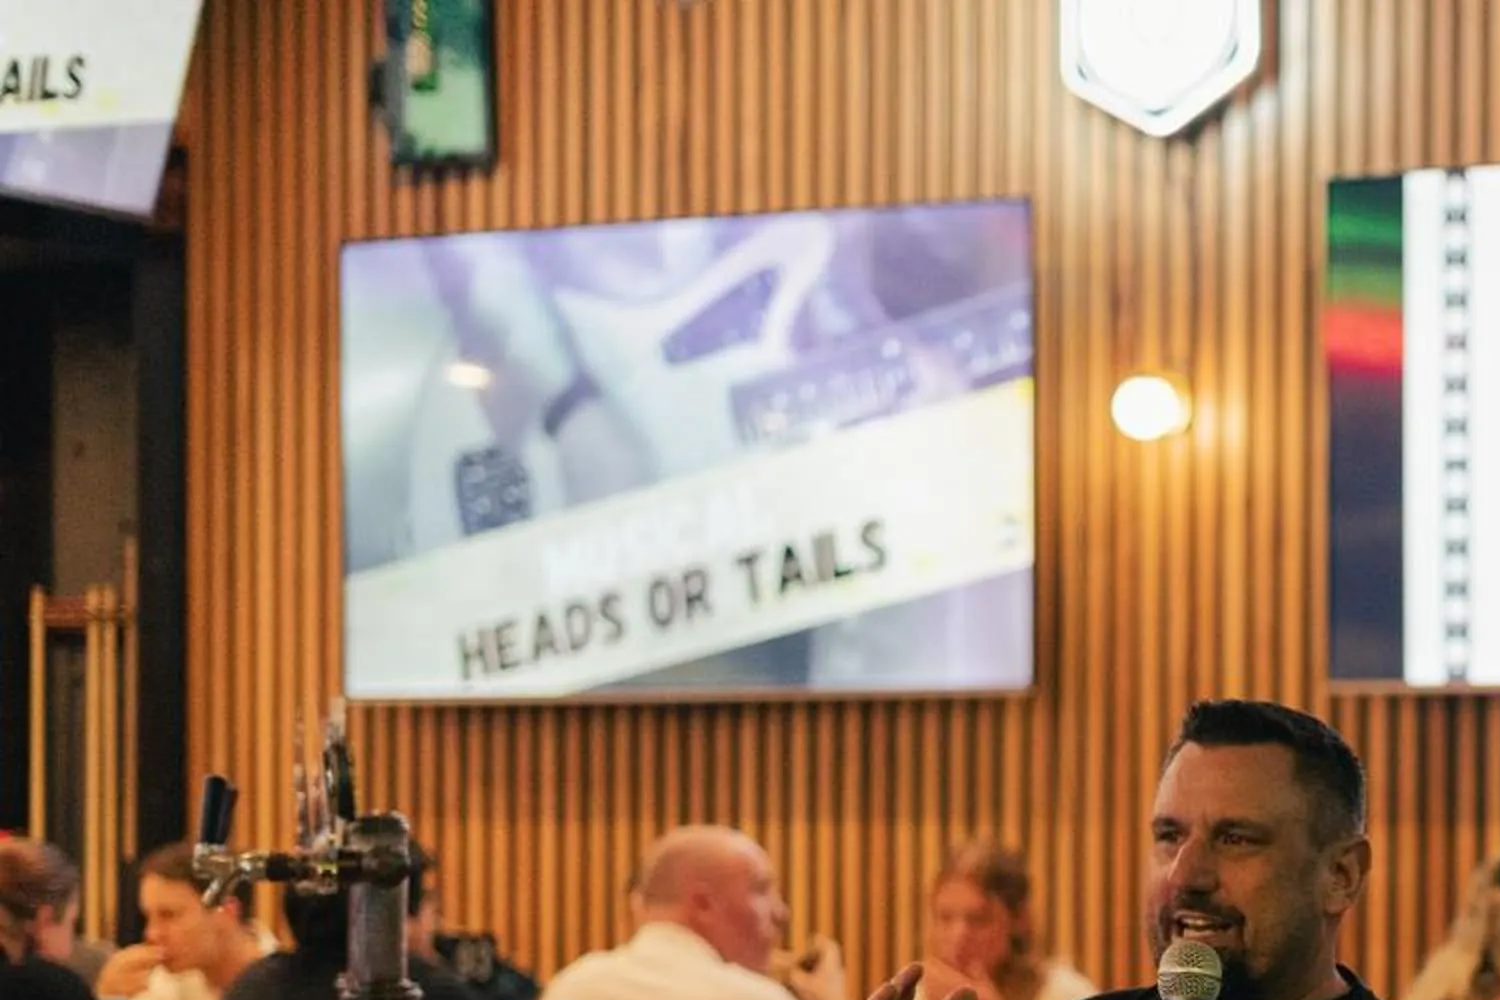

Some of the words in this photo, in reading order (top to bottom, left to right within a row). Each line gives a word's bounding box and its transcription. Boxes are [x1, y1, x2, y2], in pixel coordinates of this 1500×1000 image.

[458, 592, 626, 681] HEADS
[648, 564, 712, 632] OR
[736, 518, 889, 610] TAILS
